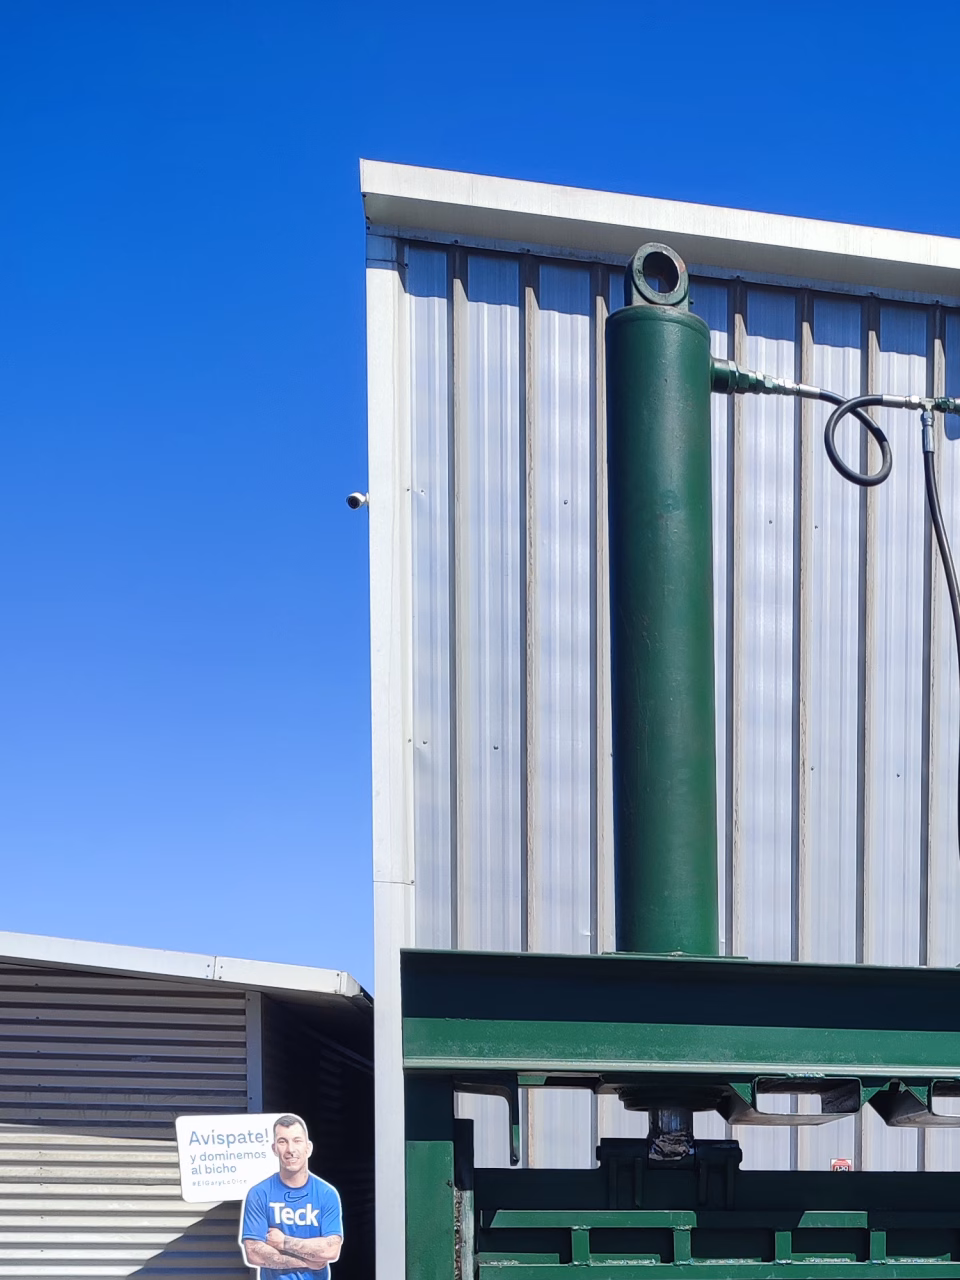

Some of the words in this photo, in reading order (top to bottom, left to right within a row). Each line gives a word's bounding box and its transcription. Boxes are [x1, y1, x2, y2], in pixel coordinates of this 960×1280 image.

[190, 1154, 196, 1164] y
[200, 1151, 266, 1162] dominemos
[191, 1164, 202, 1175] al
[205, 1163, 237, 1174] bicho
[269, 1202, 320, 1227] Teck
